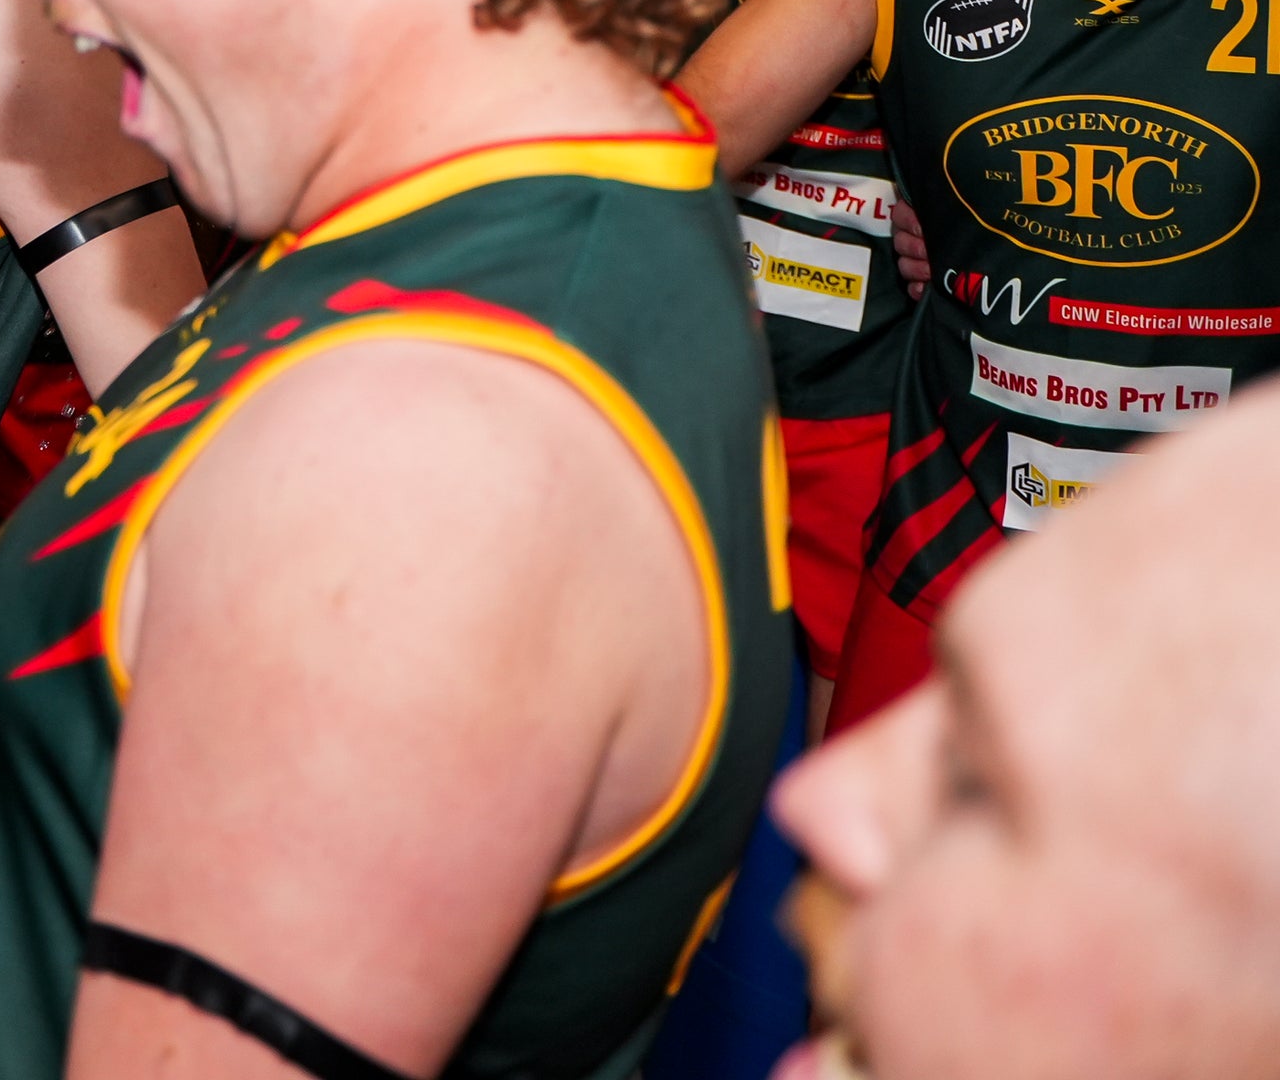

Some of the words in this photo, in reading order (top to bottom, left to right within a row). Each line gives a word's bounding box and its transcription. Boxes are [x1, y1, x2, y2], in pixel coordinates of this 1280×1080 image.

[954, 18, 1024, 52] NTFA
[982, 112, 1208, 159] BRIDGENORTH
[775, 173, 825, 203] BROS
[831, 186, 866, 216] PTY
[985, 170, 1016, 182] EST.
[1011, 143, 1179, 220] BFC
[1169, 182, 1202, 194] 1925
[1002, 208, 1113, 249] FOOTBALL
[1120, 223, 1182, 248] CLUB
[771, 261, 857, 290] IMPACT
[1061, 304, 1100, 322] CNW
[1105, 310, 1182, 330] Electrical
[1187, 315, 1273, 331] Wholesale
[977, 353, 1037, 398] BEAMS
[1046, 375, 1108, 410] BROS
[1119, 387, 1165, 413] PTY
[1175, 385, 1219, 410] LTD
